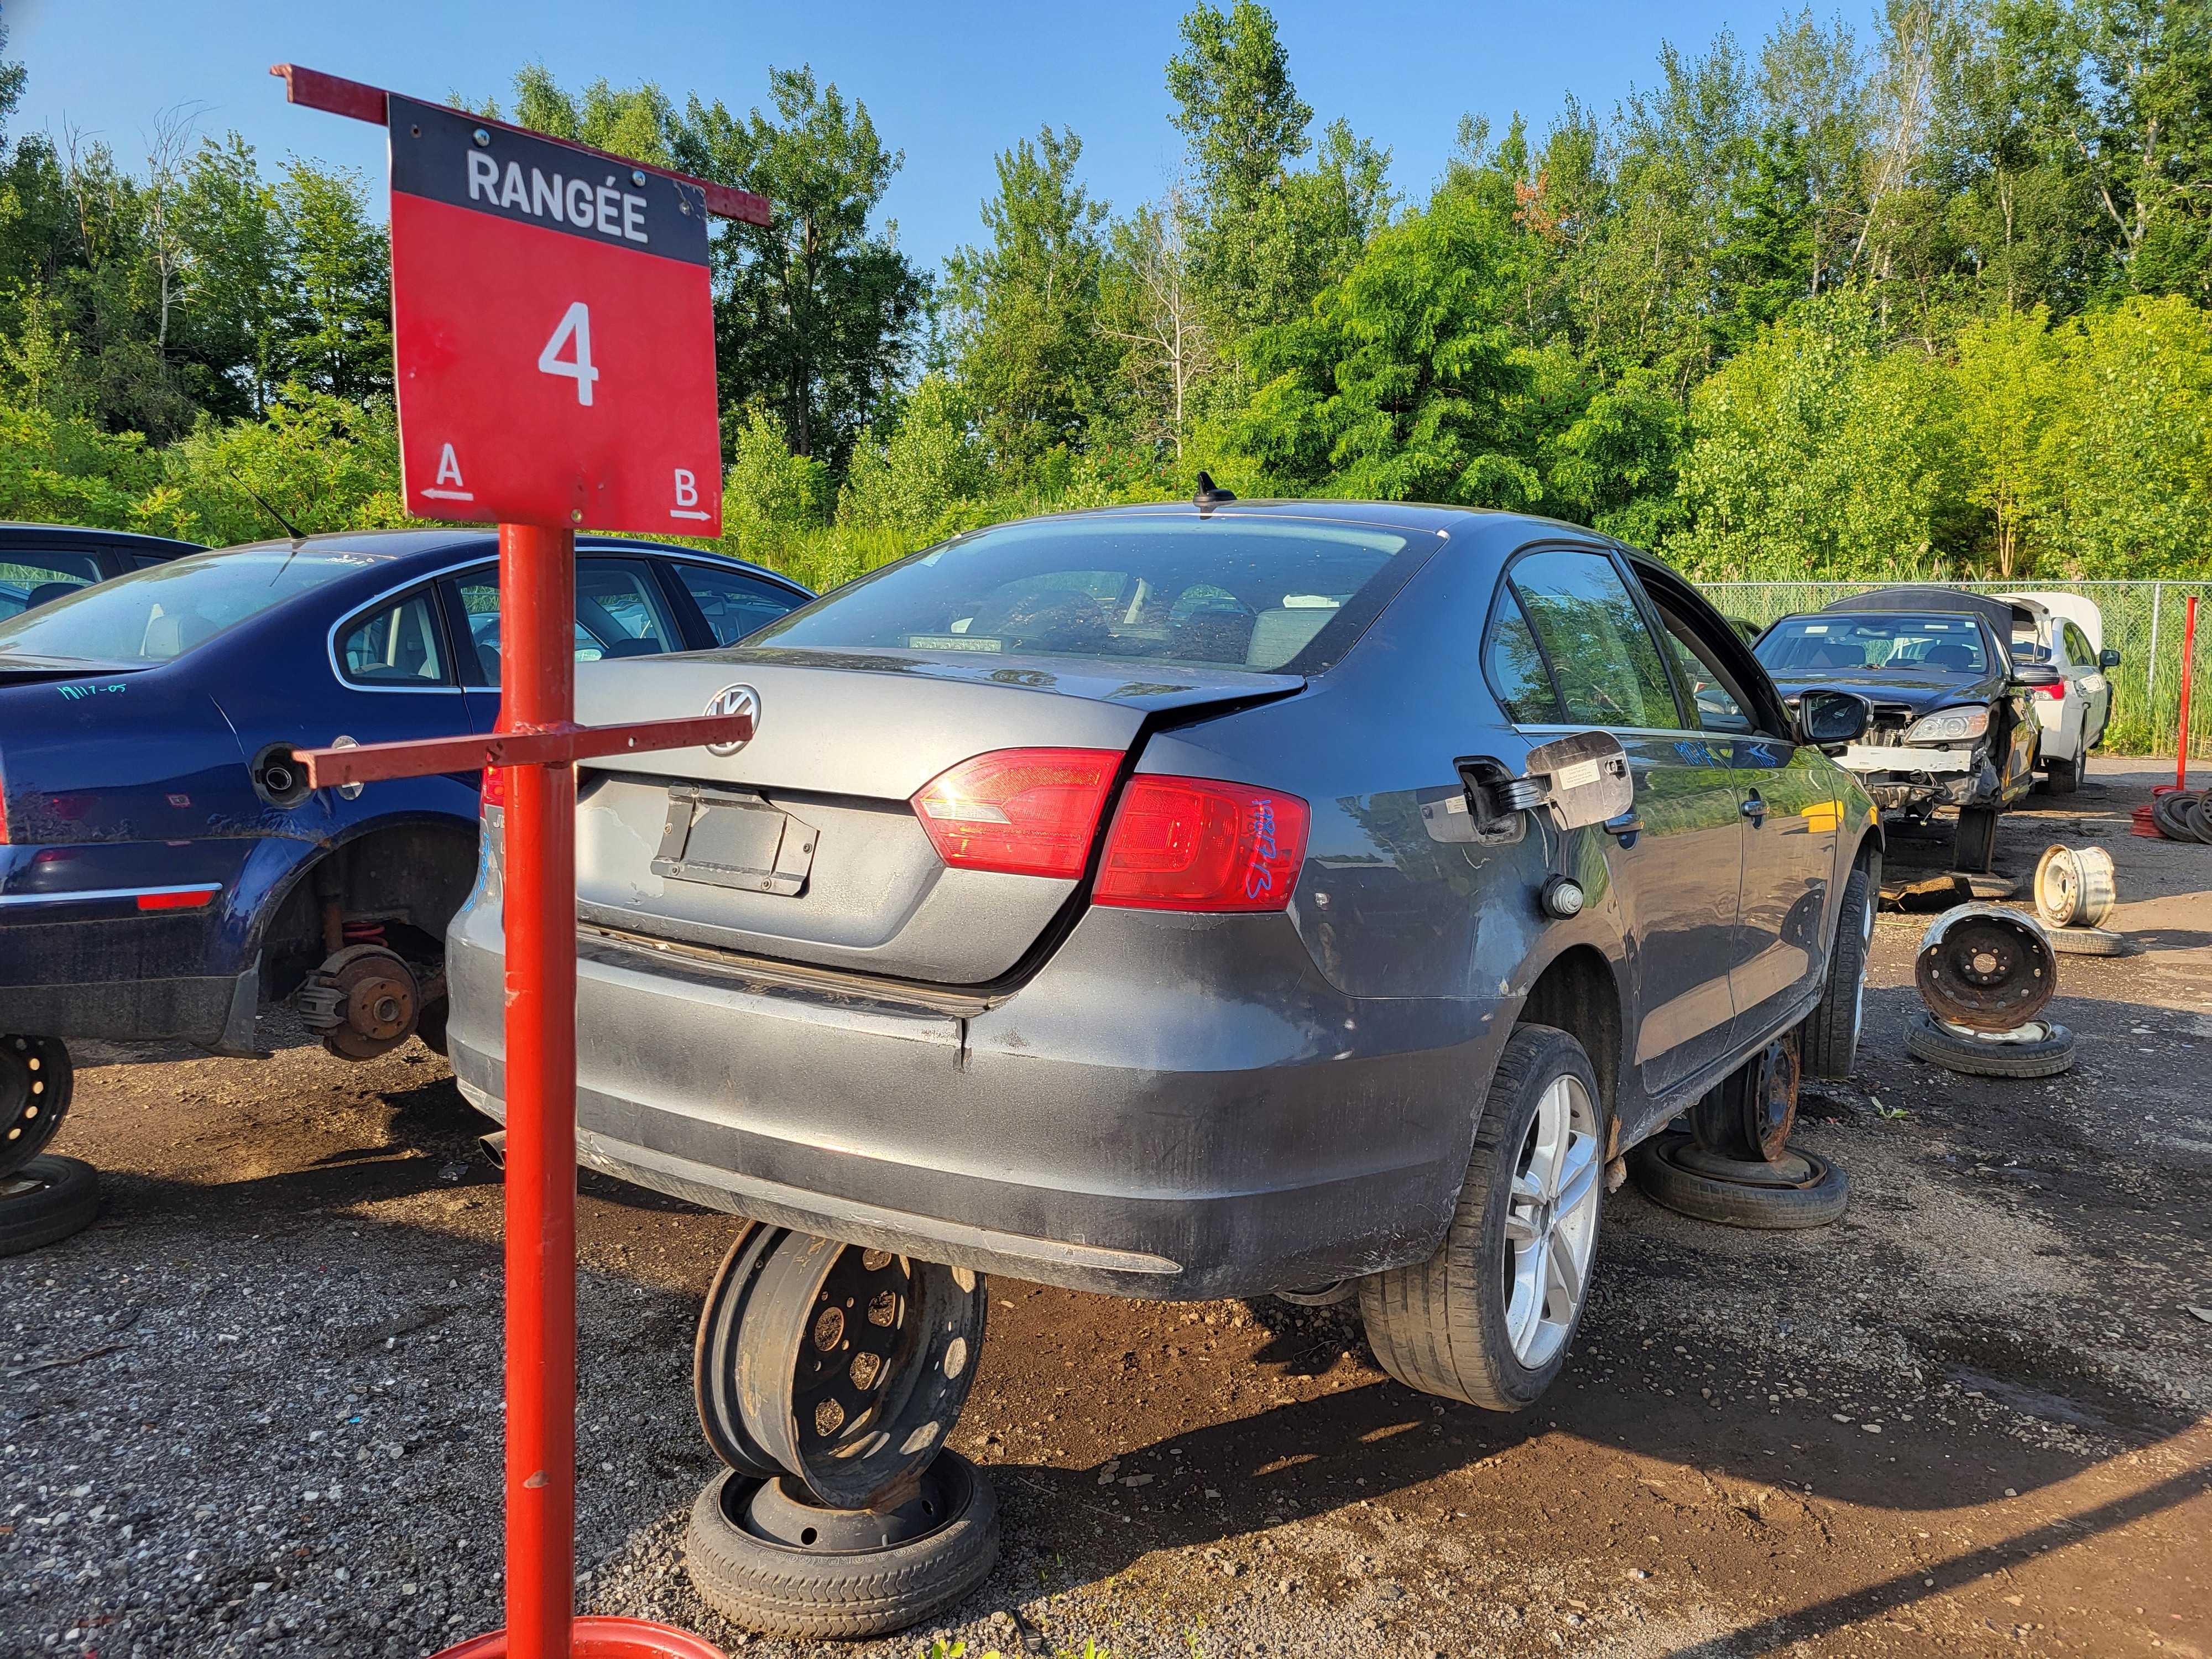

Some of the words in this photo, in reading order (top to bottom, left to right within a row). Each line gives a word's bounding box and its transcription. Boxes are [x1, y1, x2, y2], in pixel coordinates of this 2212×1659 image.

[466, 149, 648, 244] RANGÉE
[538, 301, 599, 407] 4
[436, 442, 463, 487] A
[675, 468, 698, 507] B
